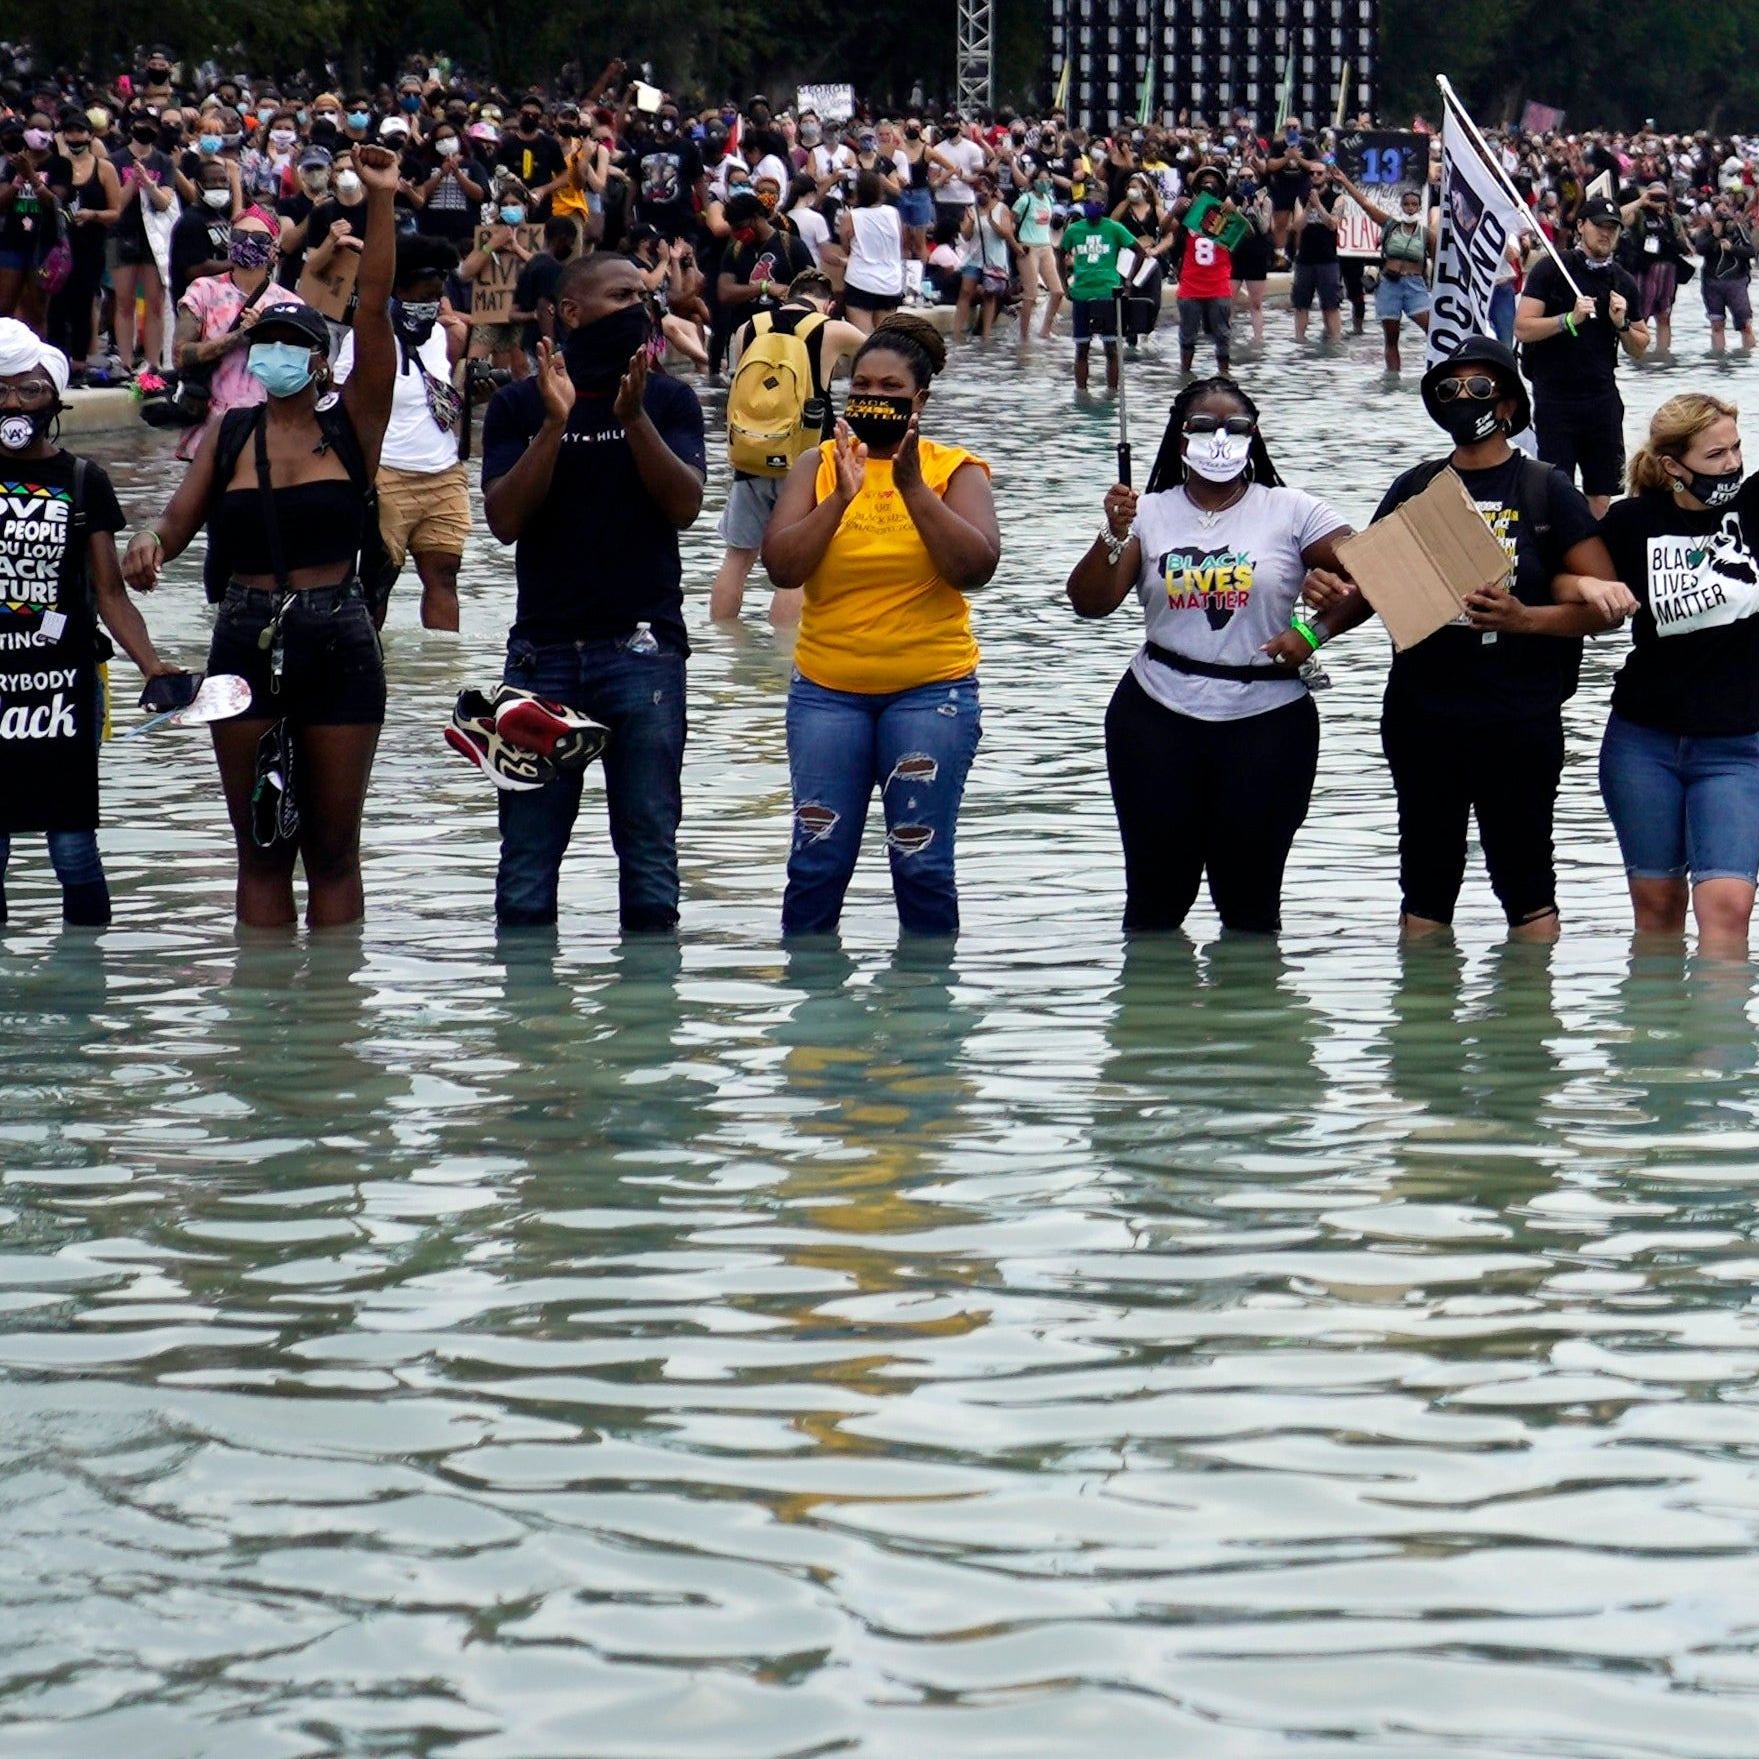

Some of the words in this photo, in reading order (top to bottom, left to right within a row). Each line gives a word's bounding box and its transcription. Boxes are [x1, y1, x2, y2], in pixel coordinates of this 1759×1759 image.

[1195, 238, 1214, 266] 8
[4, 520, 66, 543] PEOPLE
[24, 543, 65, 559] LOVE
[1166, 551, 1250, 572] BLACK
[1165, 565, 1253, 595] LIVES
[1653, 573, 1699, 598] LIVES
[1168, 590, 1250, 610] MATTER
[1655, 583, 1727, 626] MATTER
